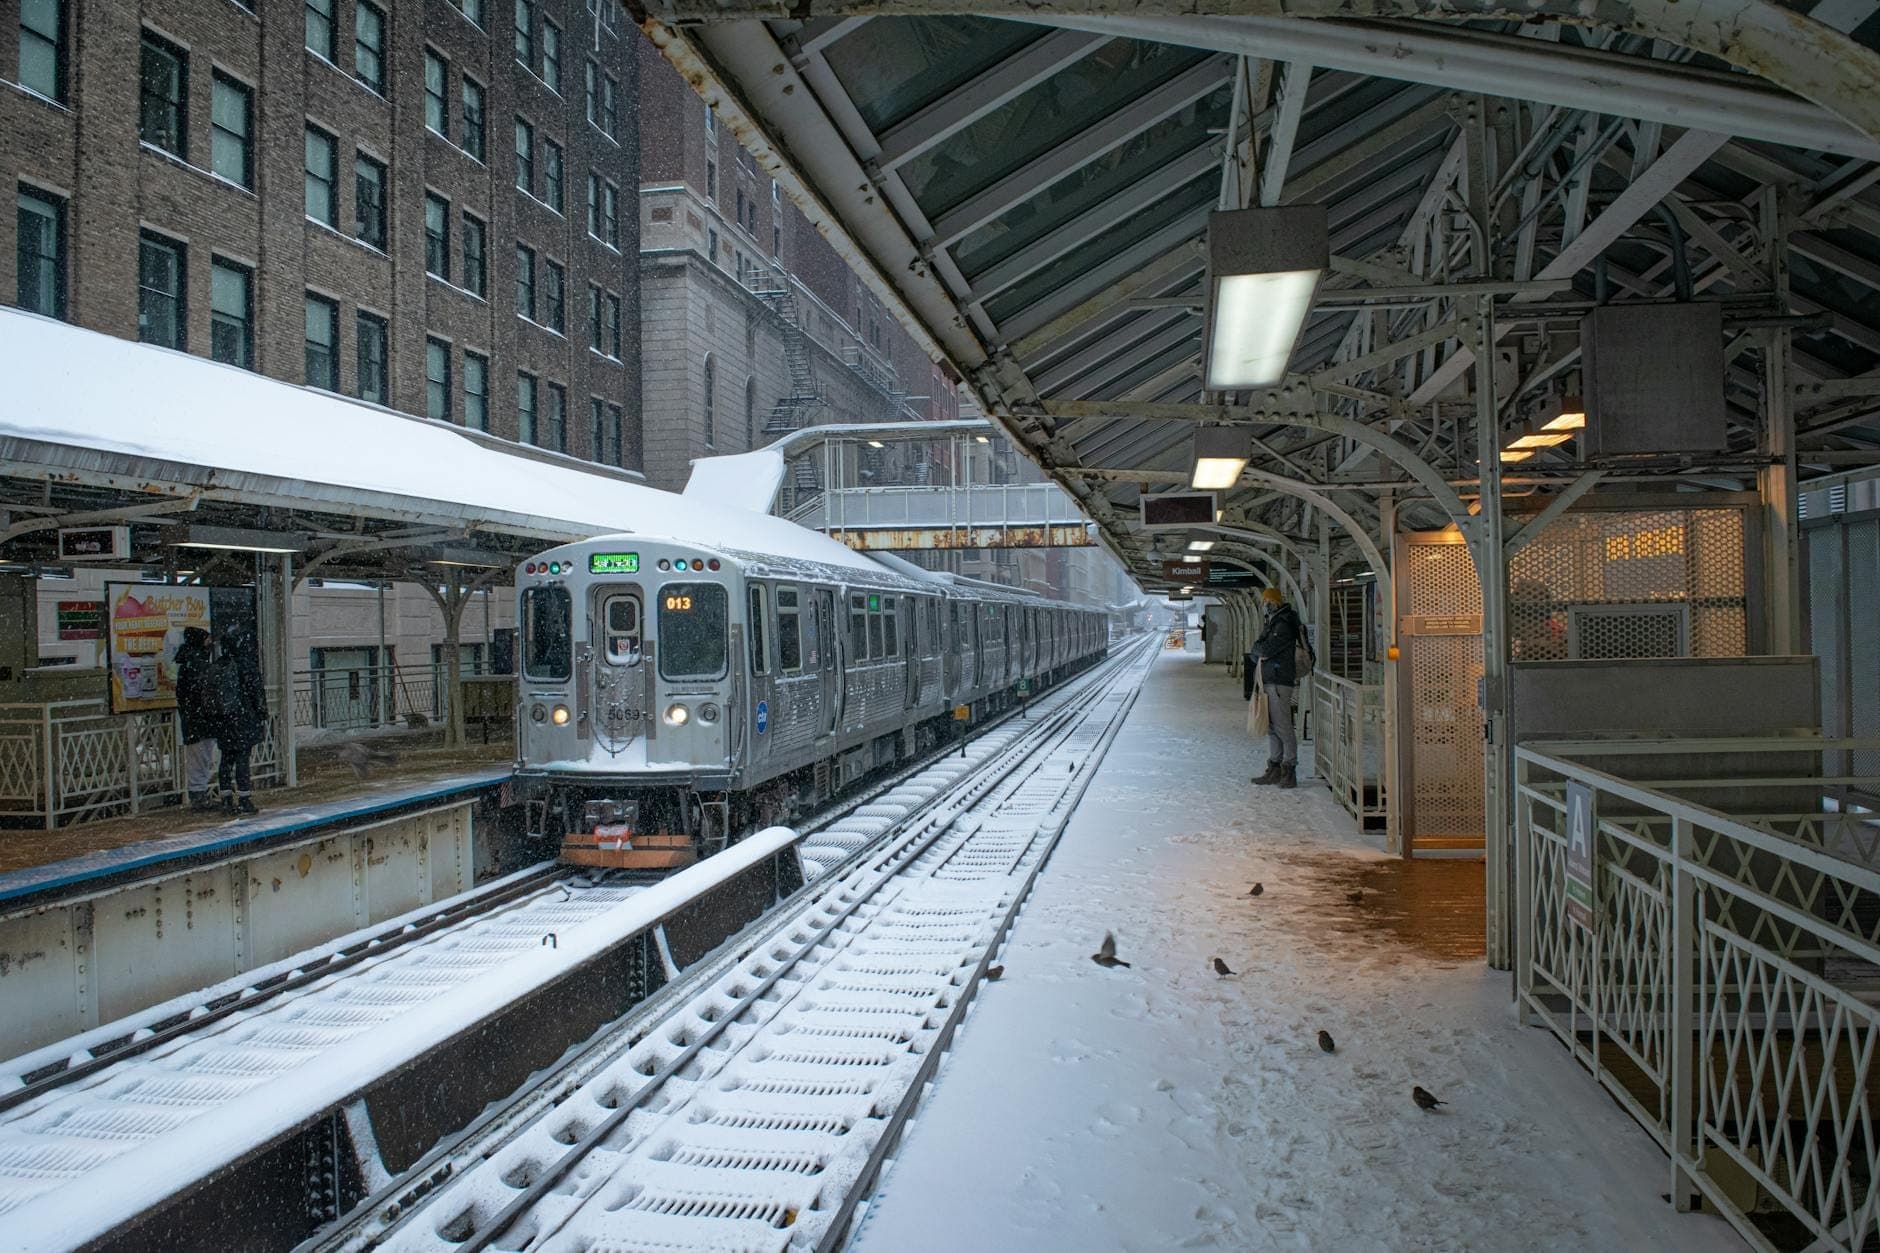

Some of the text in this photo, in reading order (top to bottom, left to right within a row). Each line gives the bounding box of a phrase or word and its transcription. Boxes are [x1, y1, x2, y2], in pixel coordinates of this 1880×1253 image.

[1172, 567, 1201, 576] Kimball
[147, 593, 206, 618] Butcher Boy
[666, 597, 691, 610] 013
[608, 708, 640, 721] 5069
[1572, 795, 1587, 858] A
